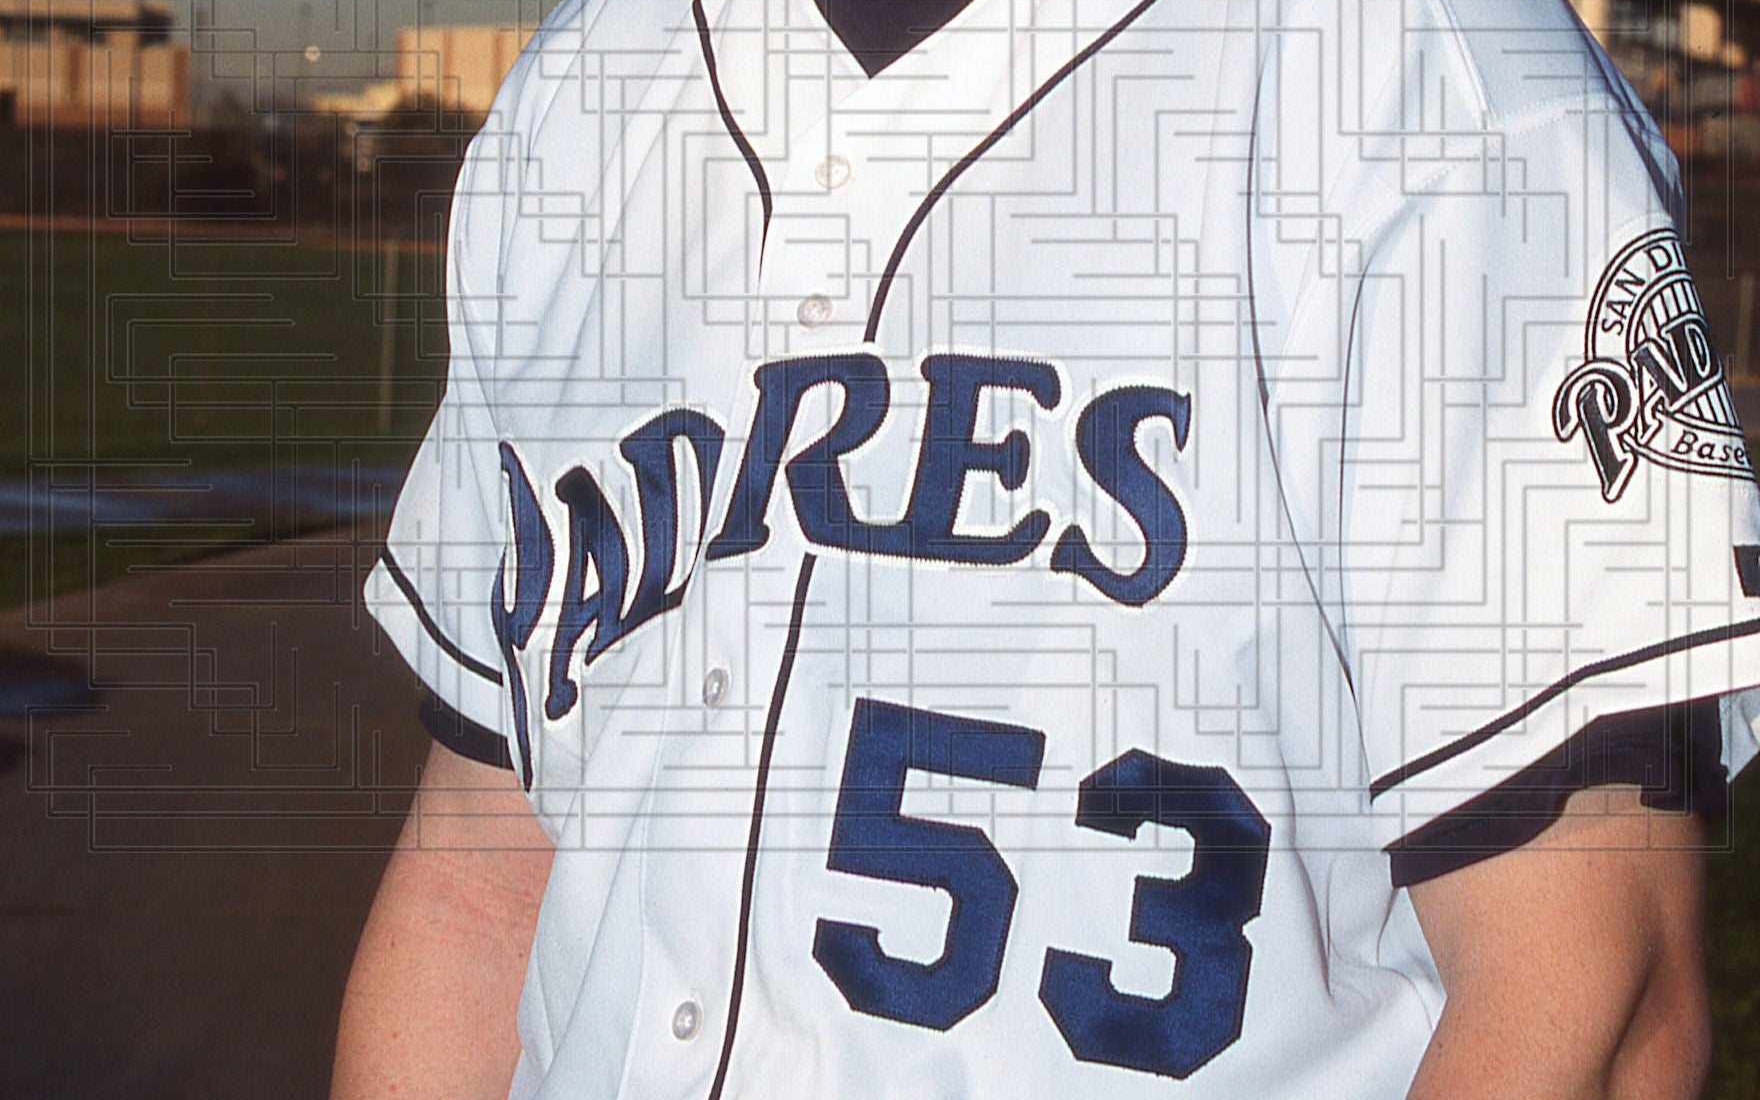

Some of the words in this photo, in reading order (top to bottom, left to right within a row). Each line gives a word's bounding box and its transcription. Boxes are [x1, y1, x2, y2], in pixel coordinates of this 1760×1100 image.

[1601, 265, 1646, 336] SAN
[491, 352, 1192, 793] PADRES
[812, 697, 1272, 1081] 53
